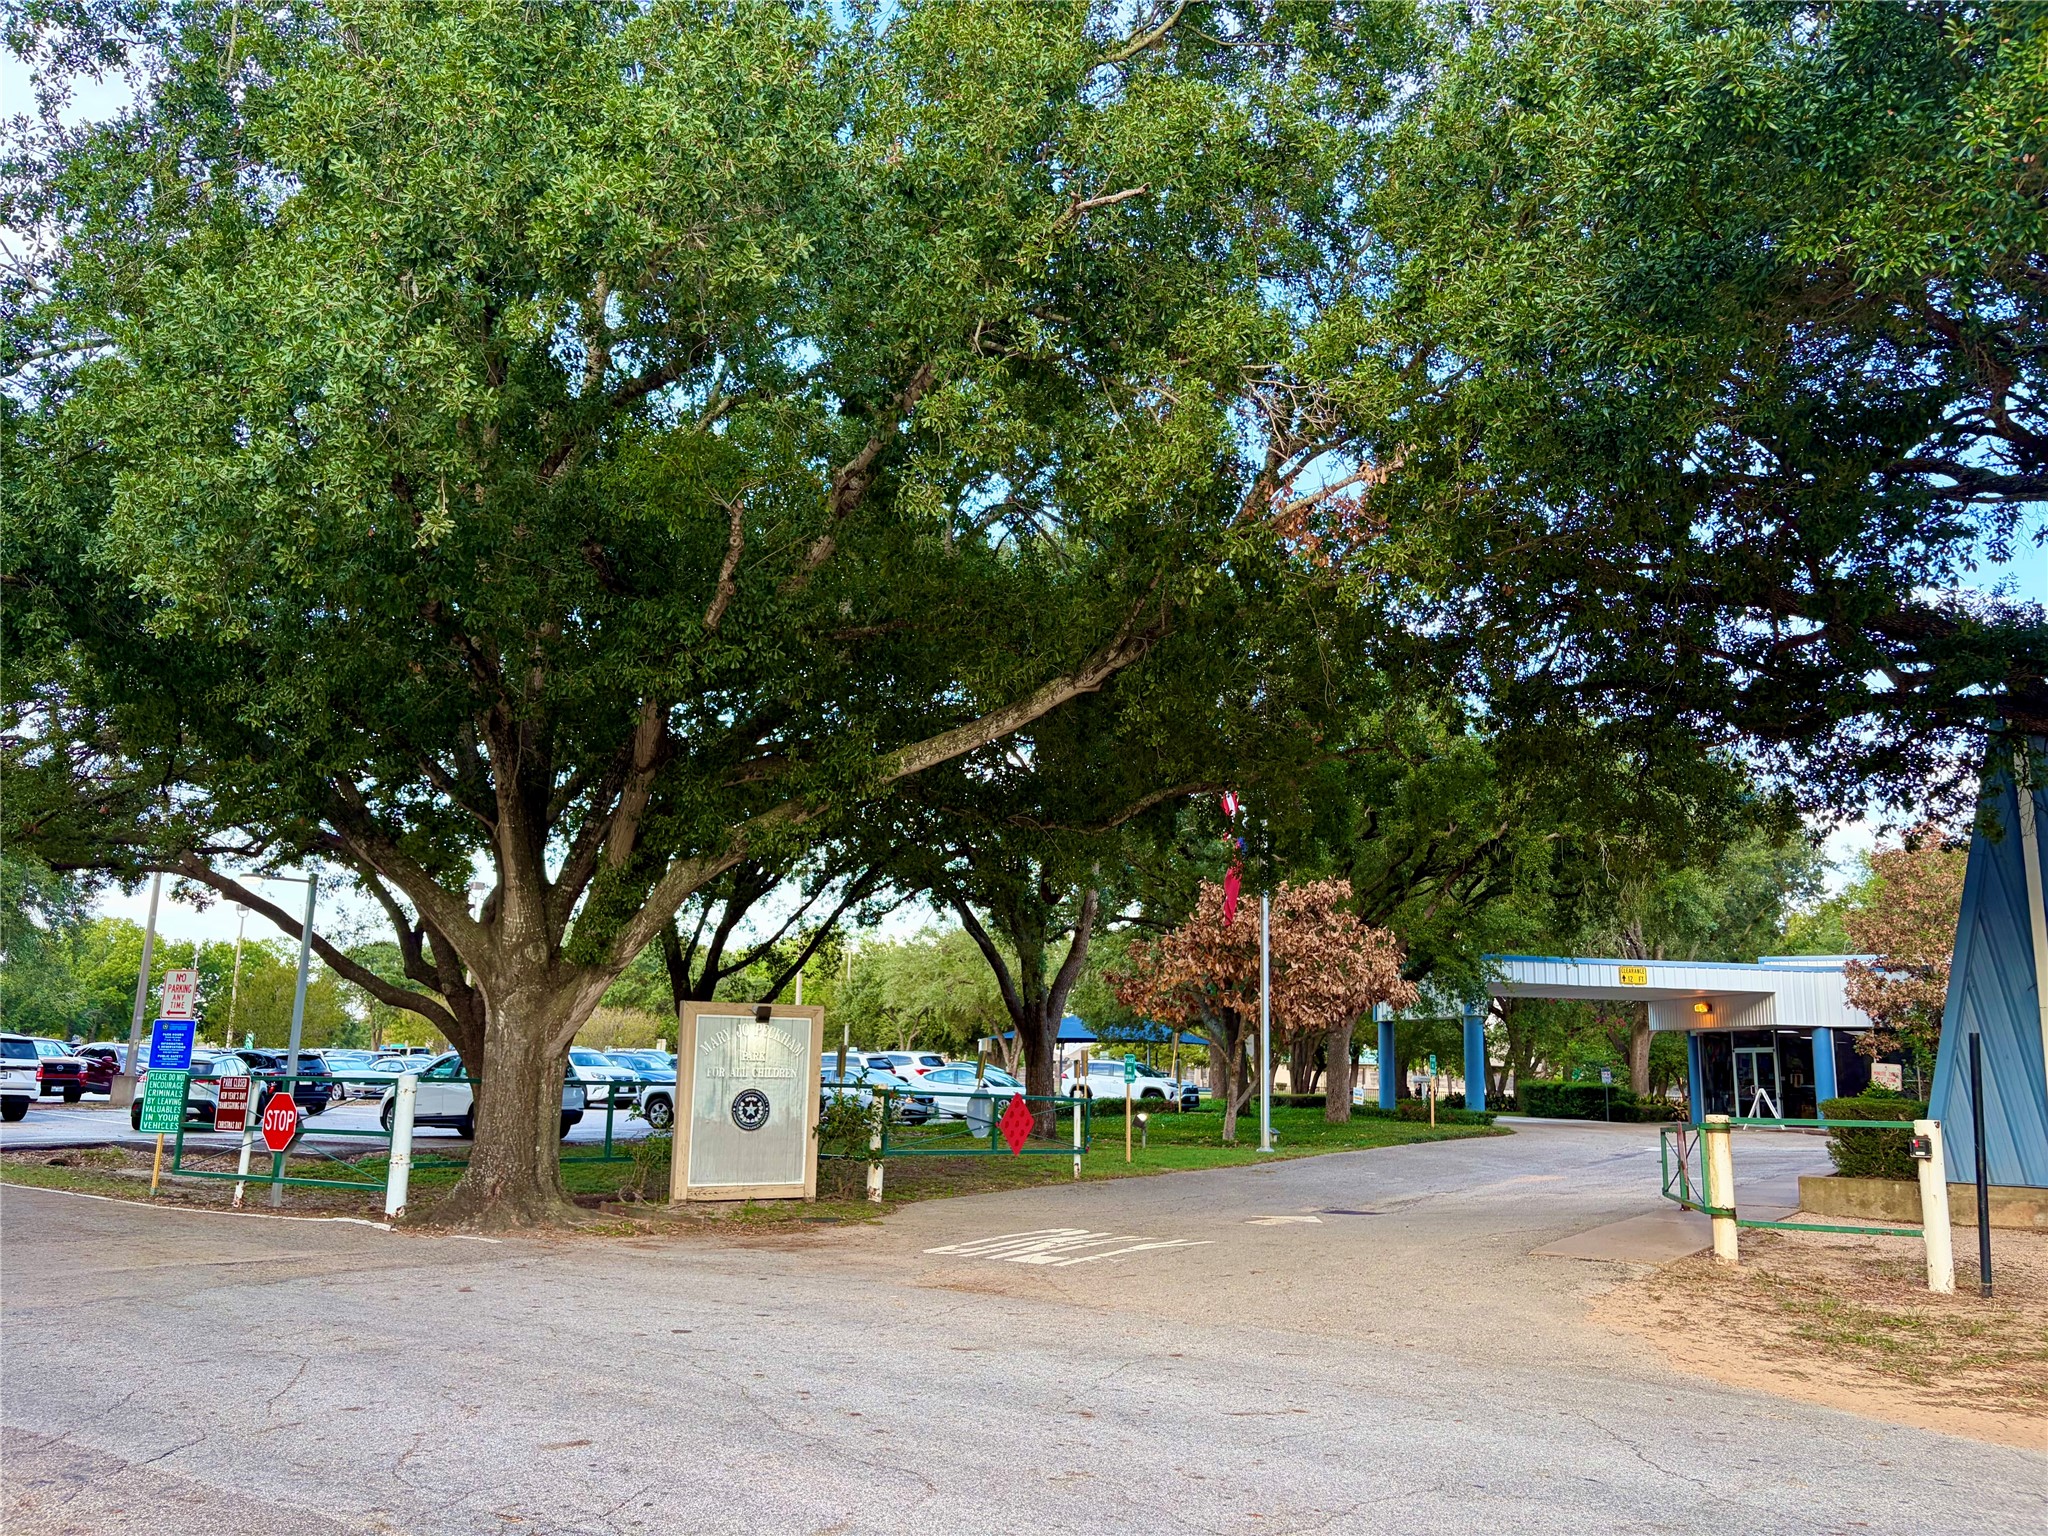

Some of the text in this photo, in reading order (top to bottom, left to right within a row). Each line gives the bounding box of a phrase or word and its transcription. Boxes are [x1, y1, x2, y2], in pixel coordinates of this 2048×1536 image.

[176, 973, 187, 982] NO
[168, 984, 192, 993] PARKING
[700, 1023, 805, 1057] MARY JO PECKHAM
[742, 1050, 766, 1061] PARK
[706, 1066, 798, 1078] FOR ALL CHILDREN
[149, 1073, 168, 1081] PLEASE
[176, 1074, 186, 1082] NOT
[149, 1082, 184, 1090] ENCOURAGE
[223, 1078, 247, 1088] PARK CLOSED
[147, 1089, 184, 1098] CRIMINALS
[157, 1098, 182, 1106] LEAVING
[145, 1106, 181, 1114] VALUABLES
[157, 1114, 179, 1122] YOUR
[265, 1109, 294, 1131] STOP
[143, 1122, 180, 1130] VEHICLES
[217, 1121, 235, 1129] CHRISTMAS
